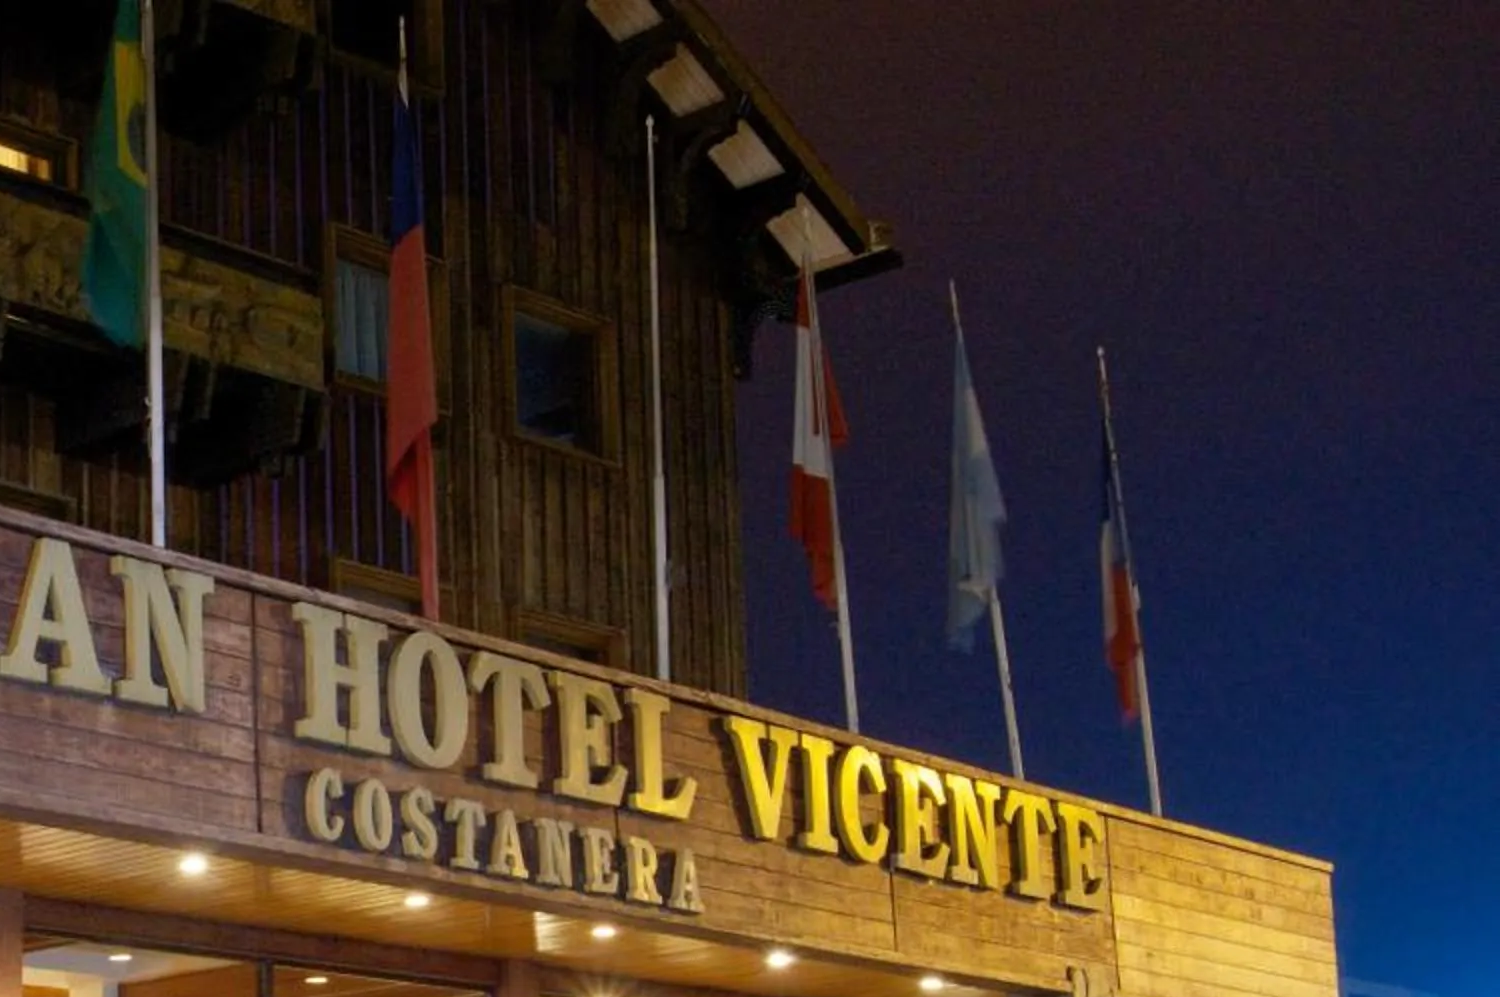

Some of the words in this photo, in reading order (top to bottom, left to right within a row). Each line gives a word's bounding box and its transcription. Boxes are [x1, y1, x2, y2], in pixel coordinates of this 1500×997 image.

[292, 601, 698, 820] HOTEL
[723, 715, 1104, 912] VICENTE
[304, 767, 705, 913] COSTANERA
